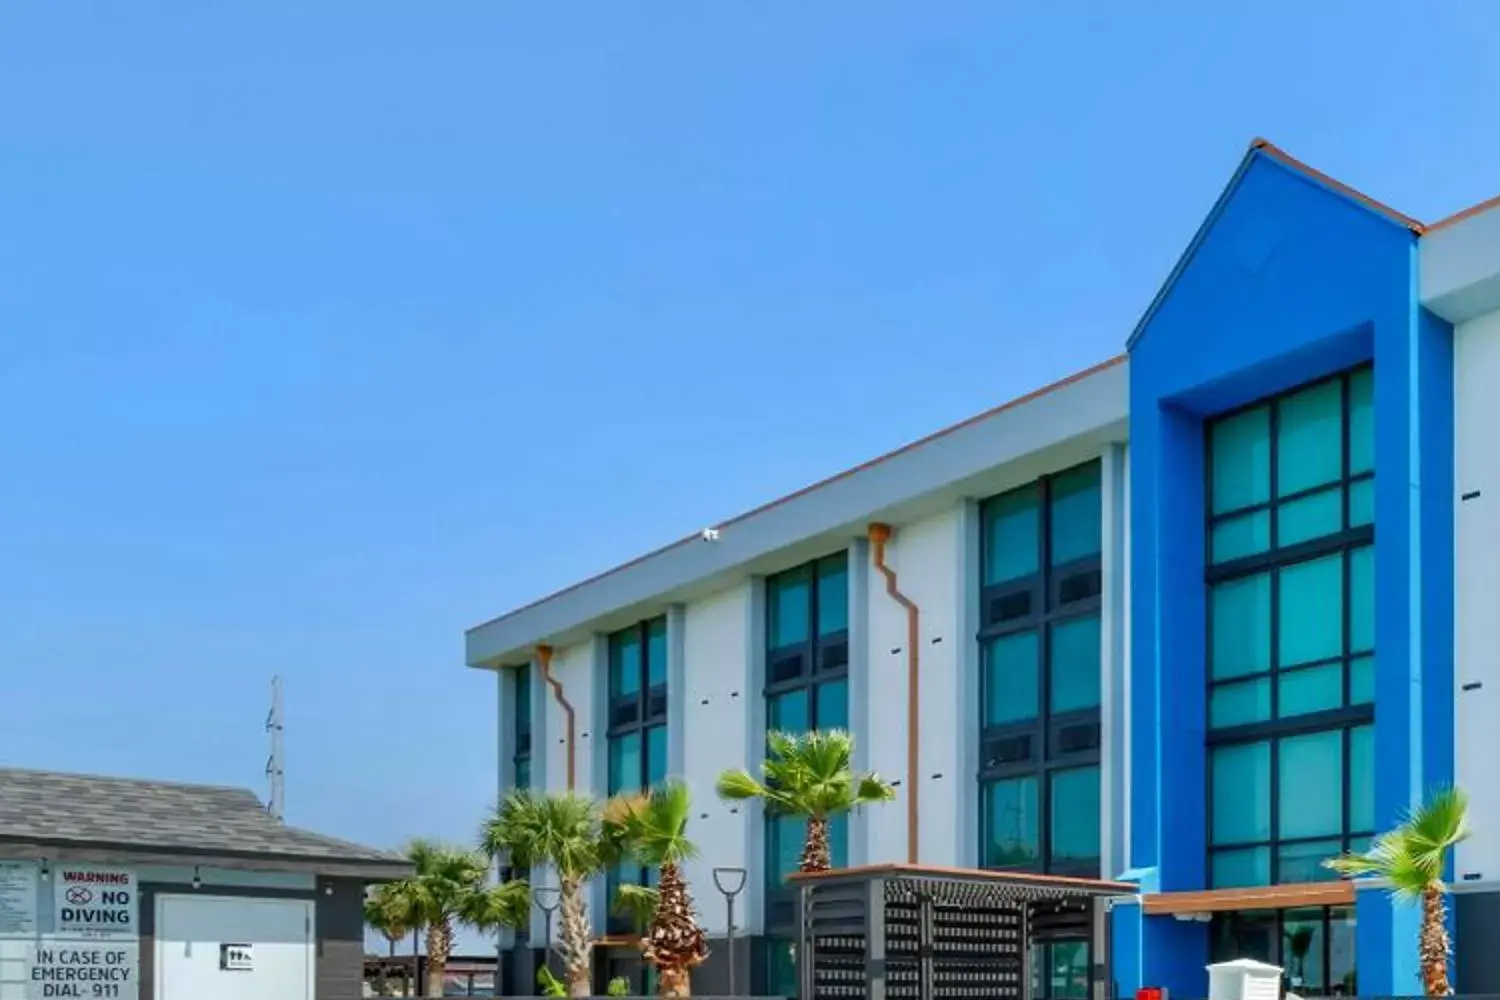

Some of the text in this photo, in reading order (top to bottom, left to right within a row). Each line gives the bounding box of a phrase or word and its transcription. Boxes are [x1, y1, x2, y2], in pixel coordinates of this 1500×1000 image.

[63, 871, 129, 884] WARNING
[102, 891, 129, 905] NO
[61, 908, 130, 923] DIVING
[37, 949, 127, 965] IN CASE OF
[31, 967, 130, 981] EMERGENCY
[92, 983, 119, 997] 911
